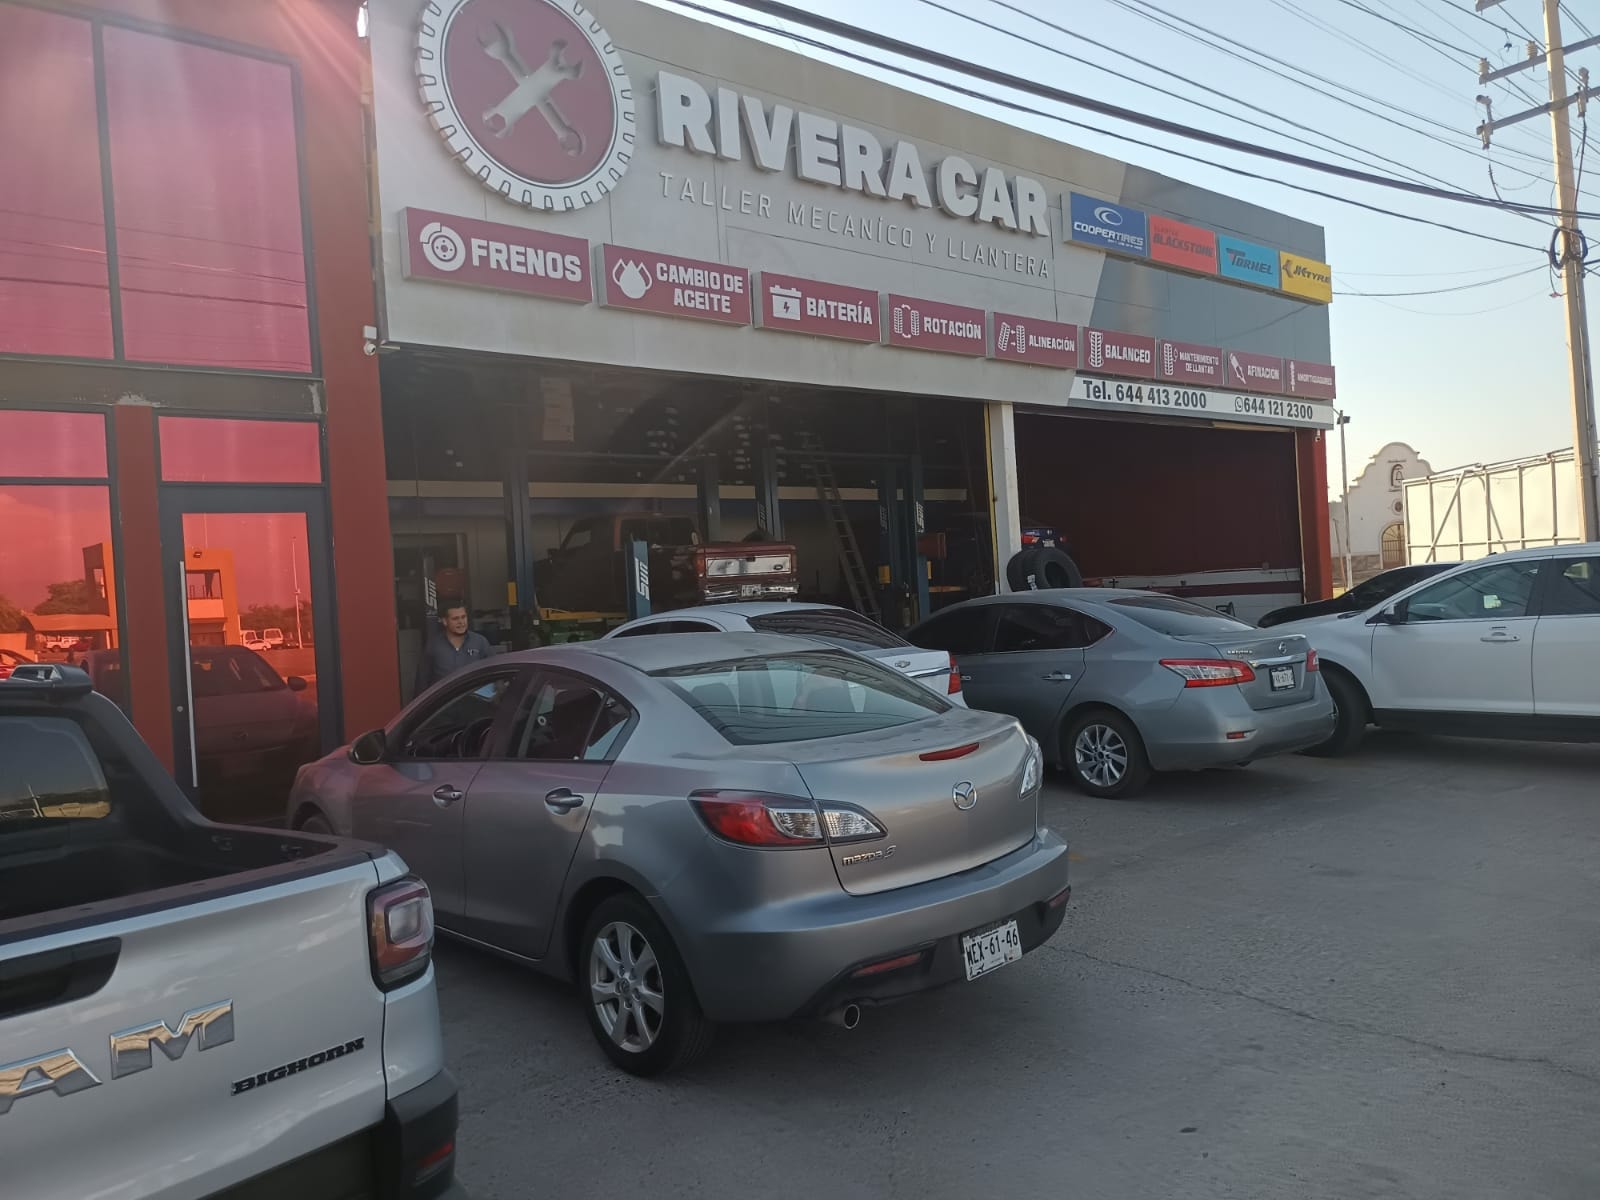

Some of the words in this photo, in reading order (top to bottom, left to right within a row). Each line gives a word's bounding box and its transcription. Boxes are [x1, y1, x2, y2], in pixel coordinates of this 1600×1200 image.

[656, 70, 933, 208] RIVERA
[936, 156, 1049, 237] CAR
[660, 171, 772, 218] TALLER
[788, 200, 914, 248] MECANÍCO
[926, 232, 937, 253] Y
[948, 237, 1049, 278] LLANTERA
[471, 237, 582, 282] FRENOS
[656, 262, 721, 290] CAMBIO
[723, 274, 744, 294] DE
[673, 288, 731, 314] ACEITE
[806, 297, 873, 325] BATERÍA
[923, 316, 982, 339] ROTACIÓN
[1028, 334, 1075, 352] ALINEACIÓN
[1105, 344, 1151, 364] BALANCEO
[1083, 379, 1111, 400] Tel.
[1115, 383, 1143, 403] 644
[1147, 387, 1170, 406] 413
[1174, 390, 1207, 408] 2000
[1243, 398, 1265, 414] 644
[1268, 399, 1284, 416] 121
[1287, 402, 1313, 420] 2300
[0, 999, 235, 1116] AM
[230, 1036, 366, 1097] BIGHORN
